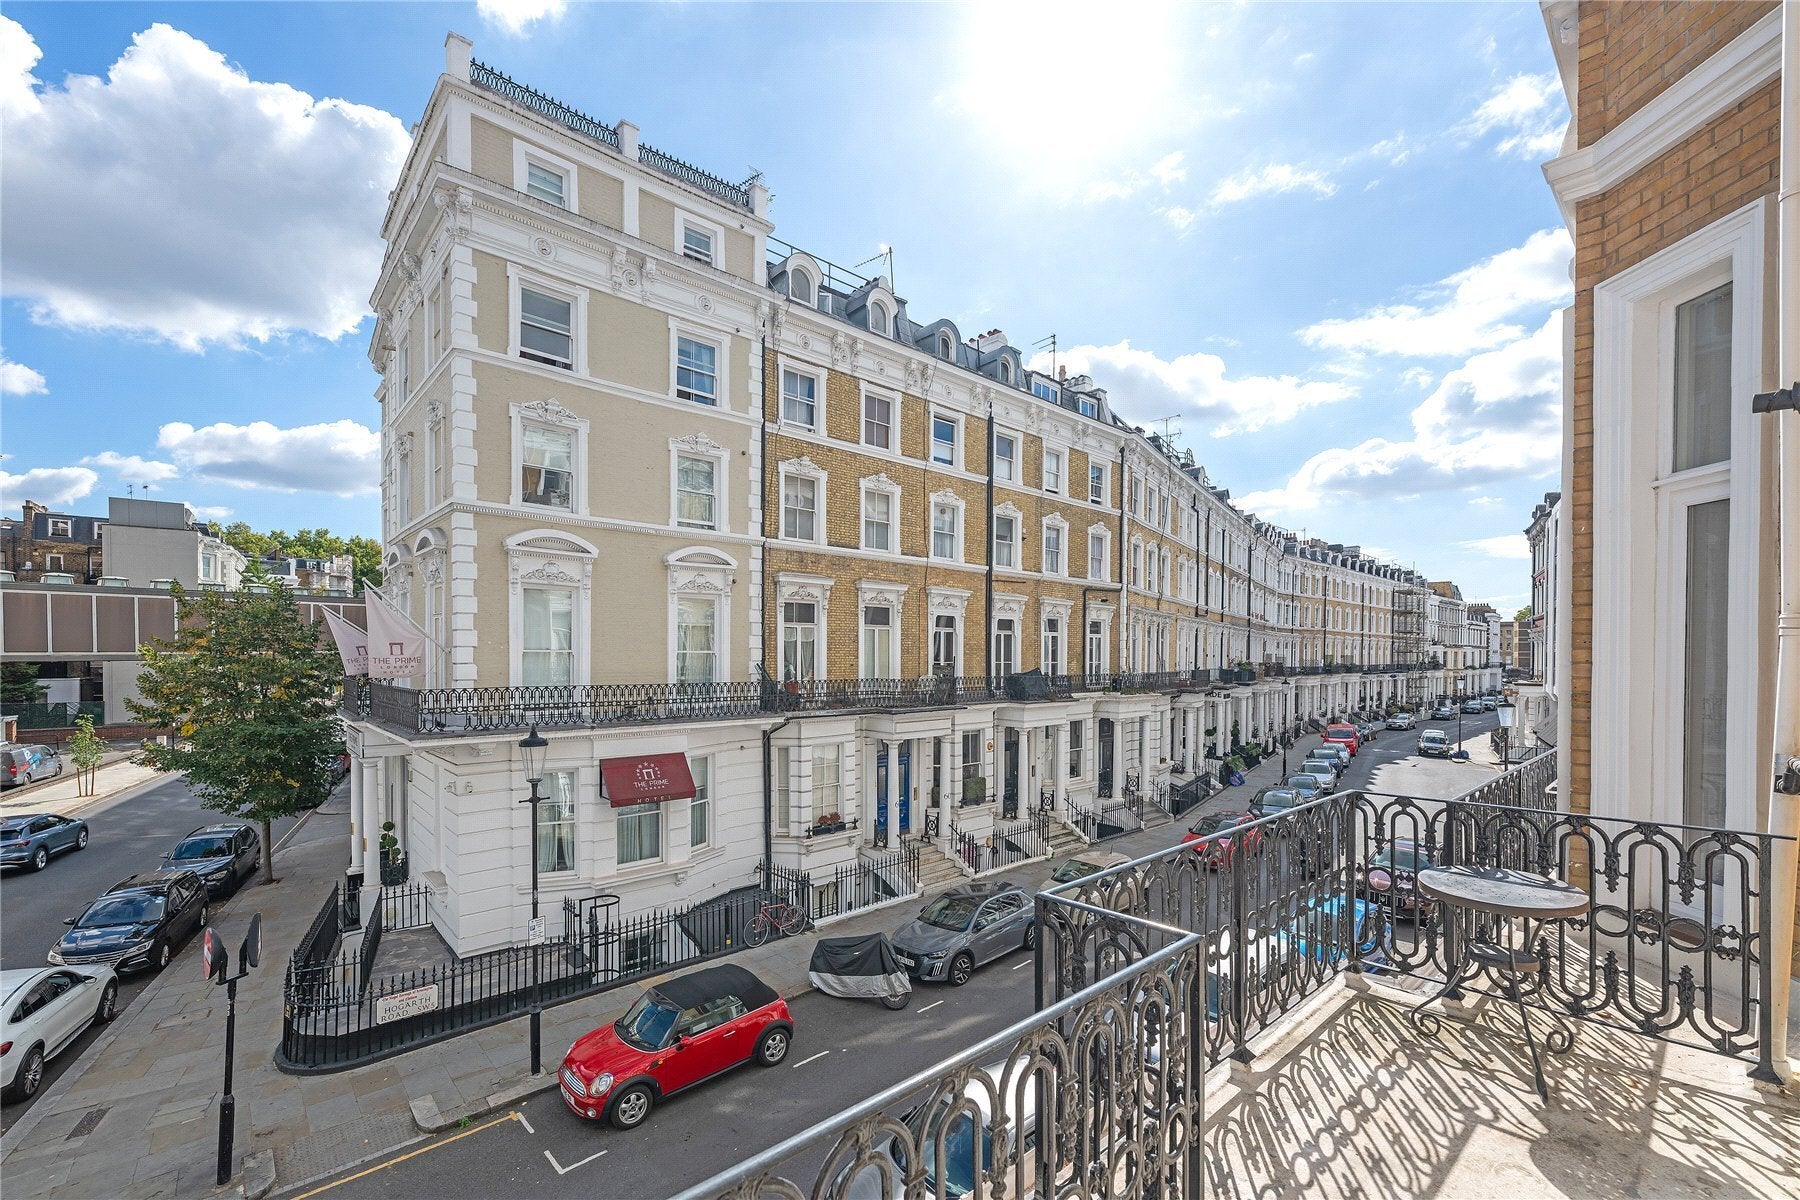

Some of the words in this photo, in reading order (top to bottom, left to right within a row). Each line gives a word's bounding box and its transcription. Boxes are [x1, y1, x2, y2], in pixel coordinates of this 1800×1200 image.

[649, 779, 669, 787] PRIME
[637, 795, 671, 803] HOTEL
[384, 996, 431, 1014] HOGARTH
